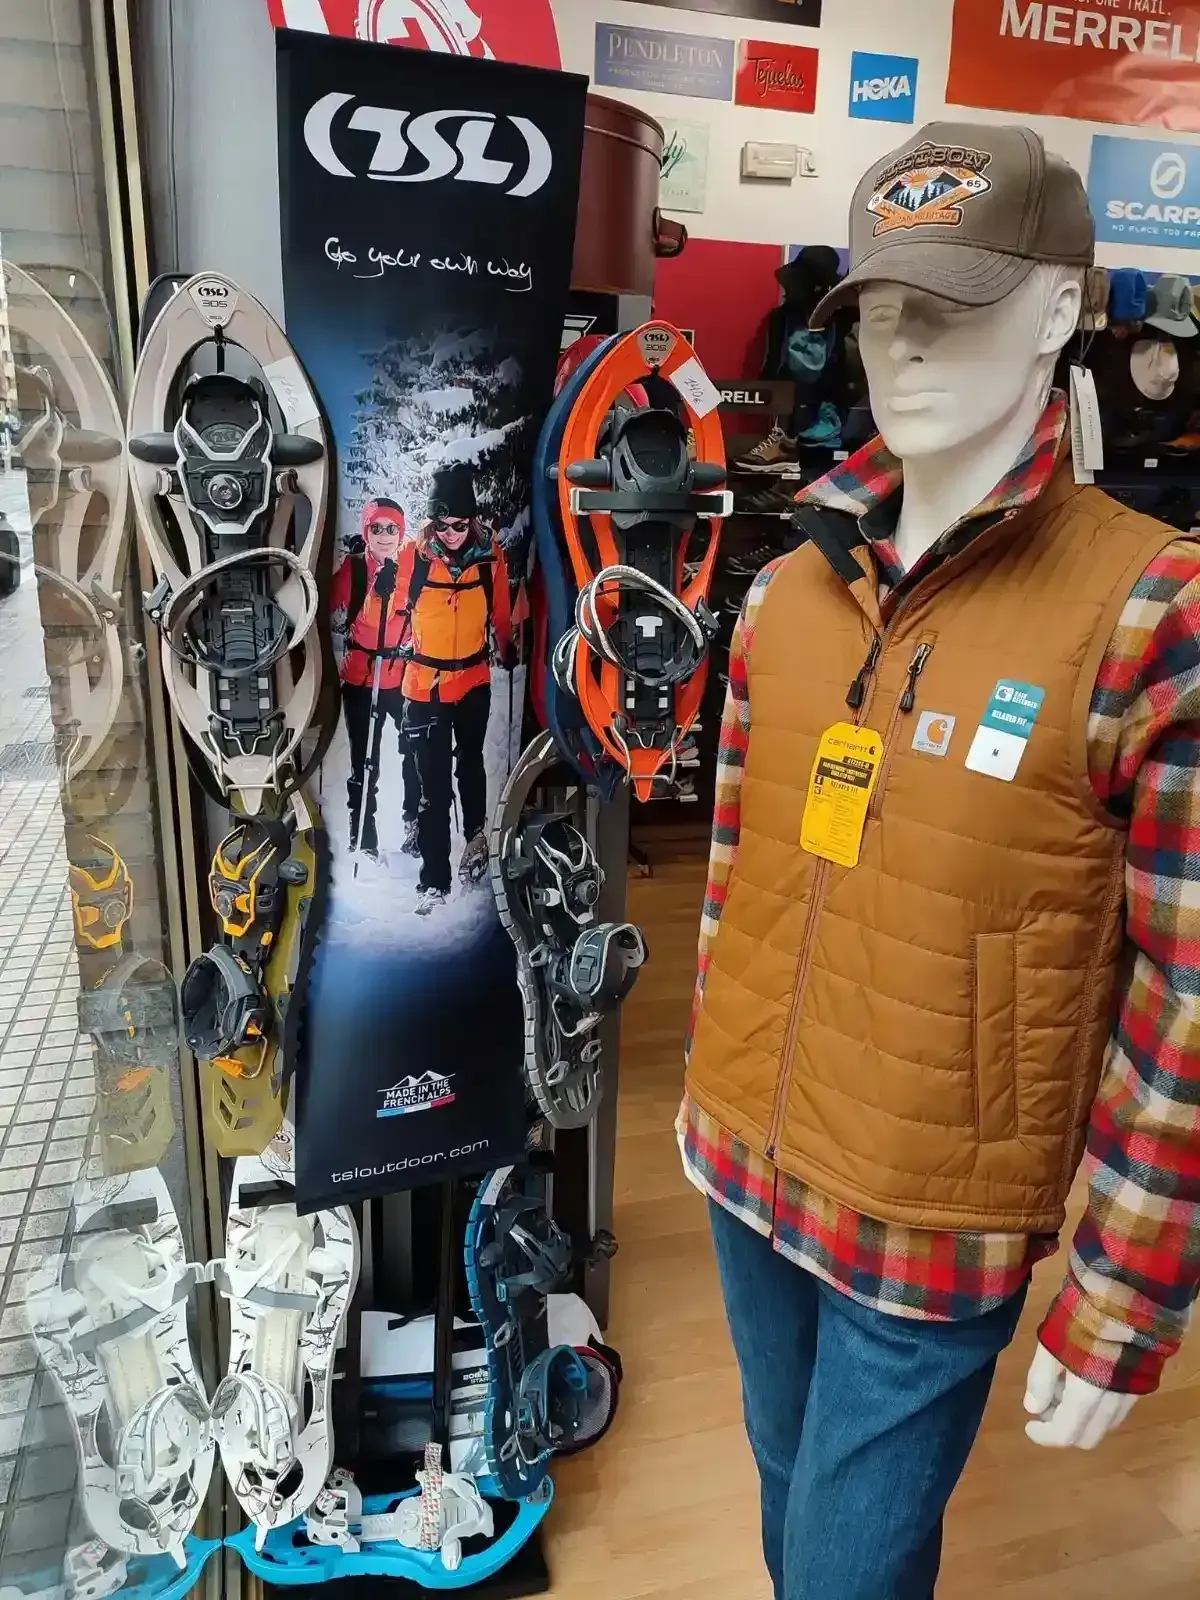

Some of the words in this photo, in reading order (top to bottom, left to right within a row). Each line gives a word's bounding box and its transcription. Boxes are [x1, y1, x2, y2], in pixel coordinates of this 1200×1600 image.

[999, 0, 1200, 64] MERREL
[607, 32, 724, 69] PENDLETON
[747, 58, 805, 98] Tejuelas
[852, 75, 912, 103] HOKA
[966, 180, 982, 188] 65
[1104, 200, 1200, 225] SCARP
[324, 236, 357, 270] Go
[353, 247, 421, 278] your
[487, 257, 533, 292] way
[202, 299, 228, 307] 305
[720, 390, 765, 404] RELL
[383, 1095, 425, 1108] FRENCH
[426, 1086, 452, 1101] ALPS
[386, 1086, 416, 1100] MADE
[418, 1083, 429, 1093] IN
[431, 1078, 450, 1090] THE
[331, 1138, 490, 1183] tsloutdoor.com
